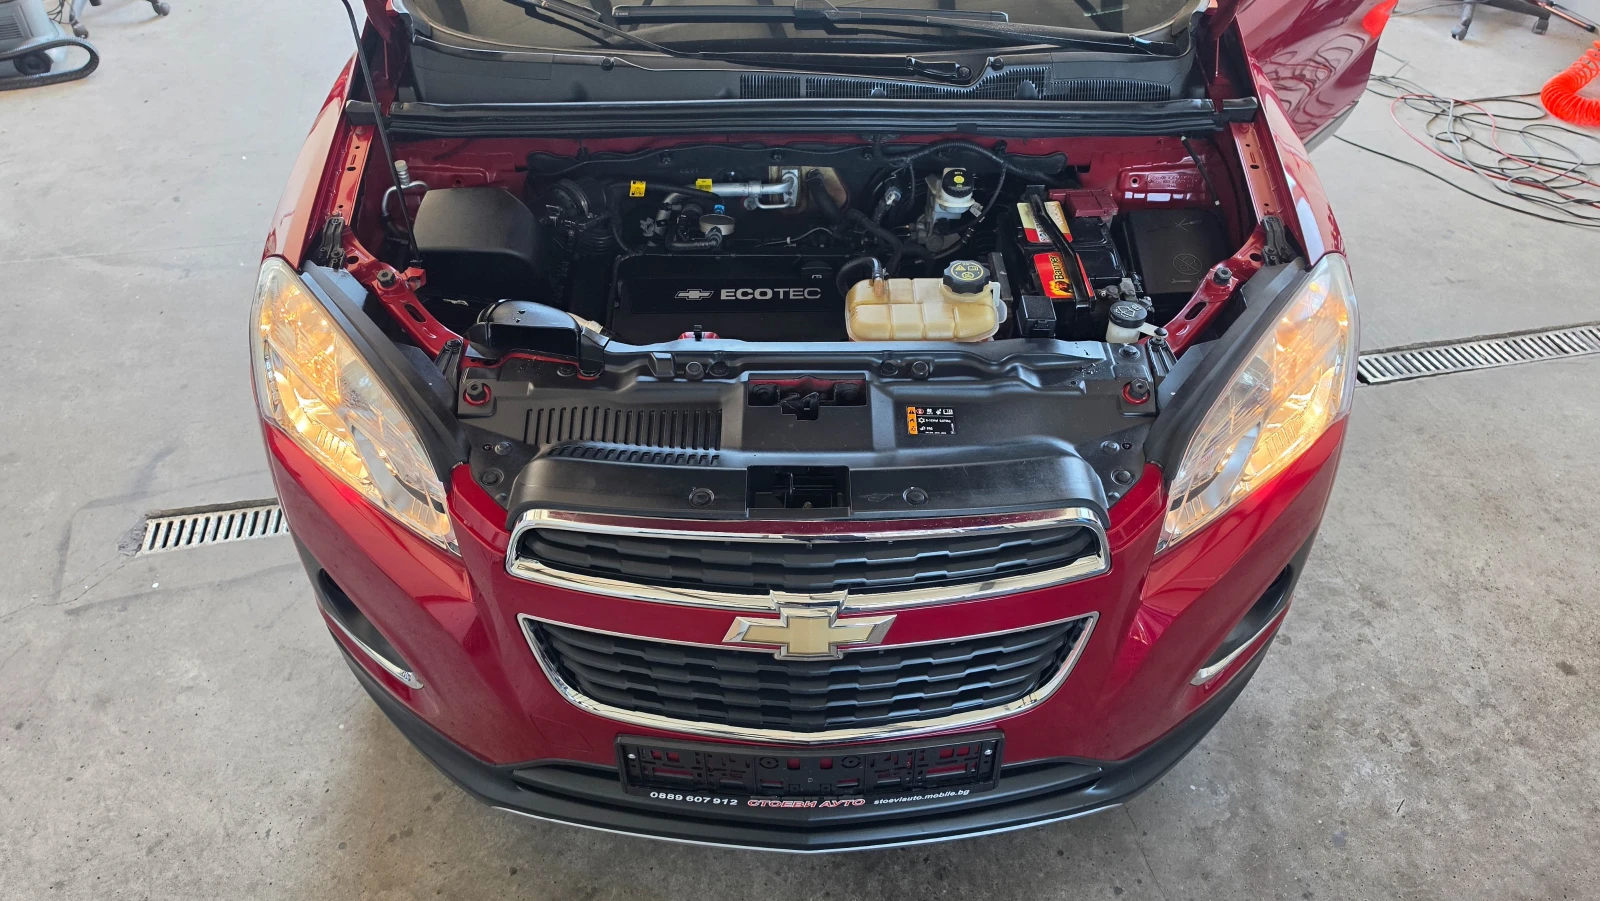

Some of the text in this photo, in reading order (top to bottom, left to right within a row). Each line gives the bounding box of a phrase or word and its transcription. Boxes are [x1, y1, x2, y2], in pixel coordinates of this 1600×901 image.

[1049, 255, 1065, 280] Banner
[720, 288, 822, 300] ECOTEC
[649, 791, 739, 806] 0889 607 912
[873, 789, 970, 805] stoeviauto.mobile.bg
